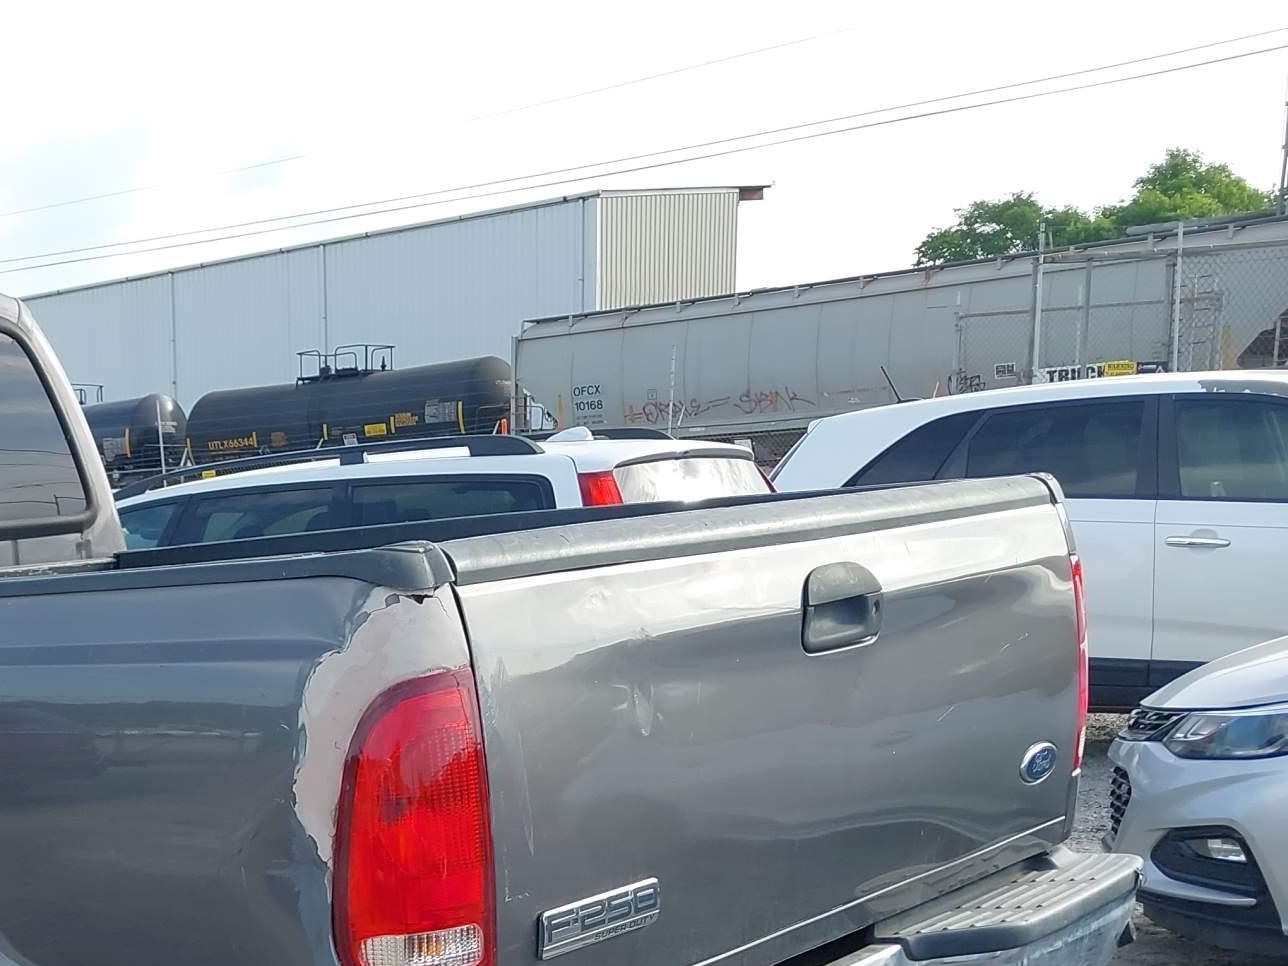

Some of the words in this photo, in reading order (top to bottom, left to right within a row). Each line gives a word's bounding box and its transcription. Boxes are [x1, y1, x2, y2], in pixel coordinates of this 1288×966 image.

[573, 384, 601, 397] OFCX
[575, 399, 603, 411] 10168
[593, 923, 628, 941] SUPER
[627, 912, 659, 929] DUTY
